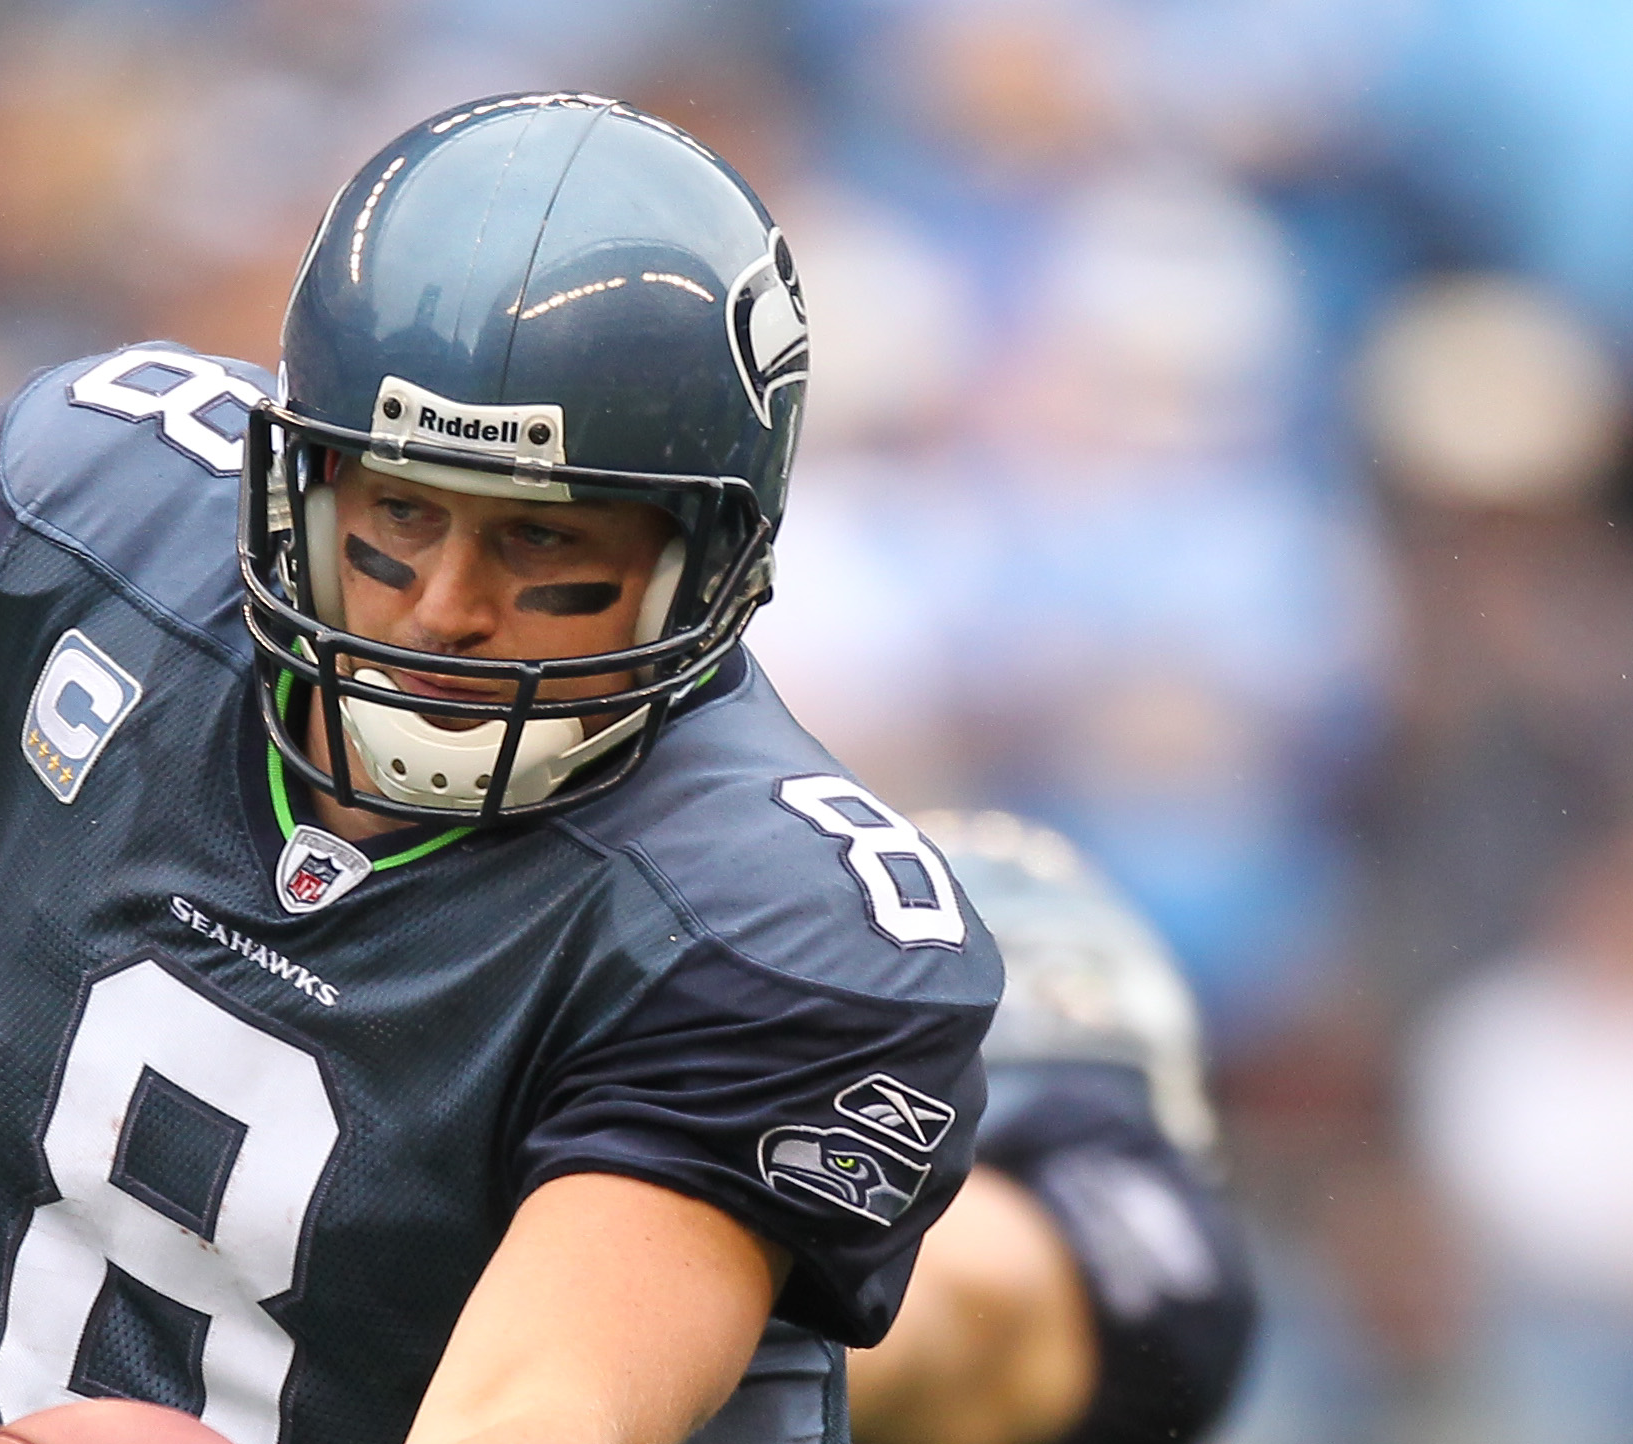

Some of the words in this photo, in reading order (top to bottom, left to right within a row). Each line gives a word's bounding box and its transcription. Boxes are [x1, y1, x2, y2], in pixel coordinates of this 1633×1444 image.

[69, 349, 272, 471] 8
[419, 407, 518, 443] Riddell
[37, 648, 124, 760] C
[777, 774, 967, 950] 8
[170, 895, 340, 1006] SEAHAWKS
